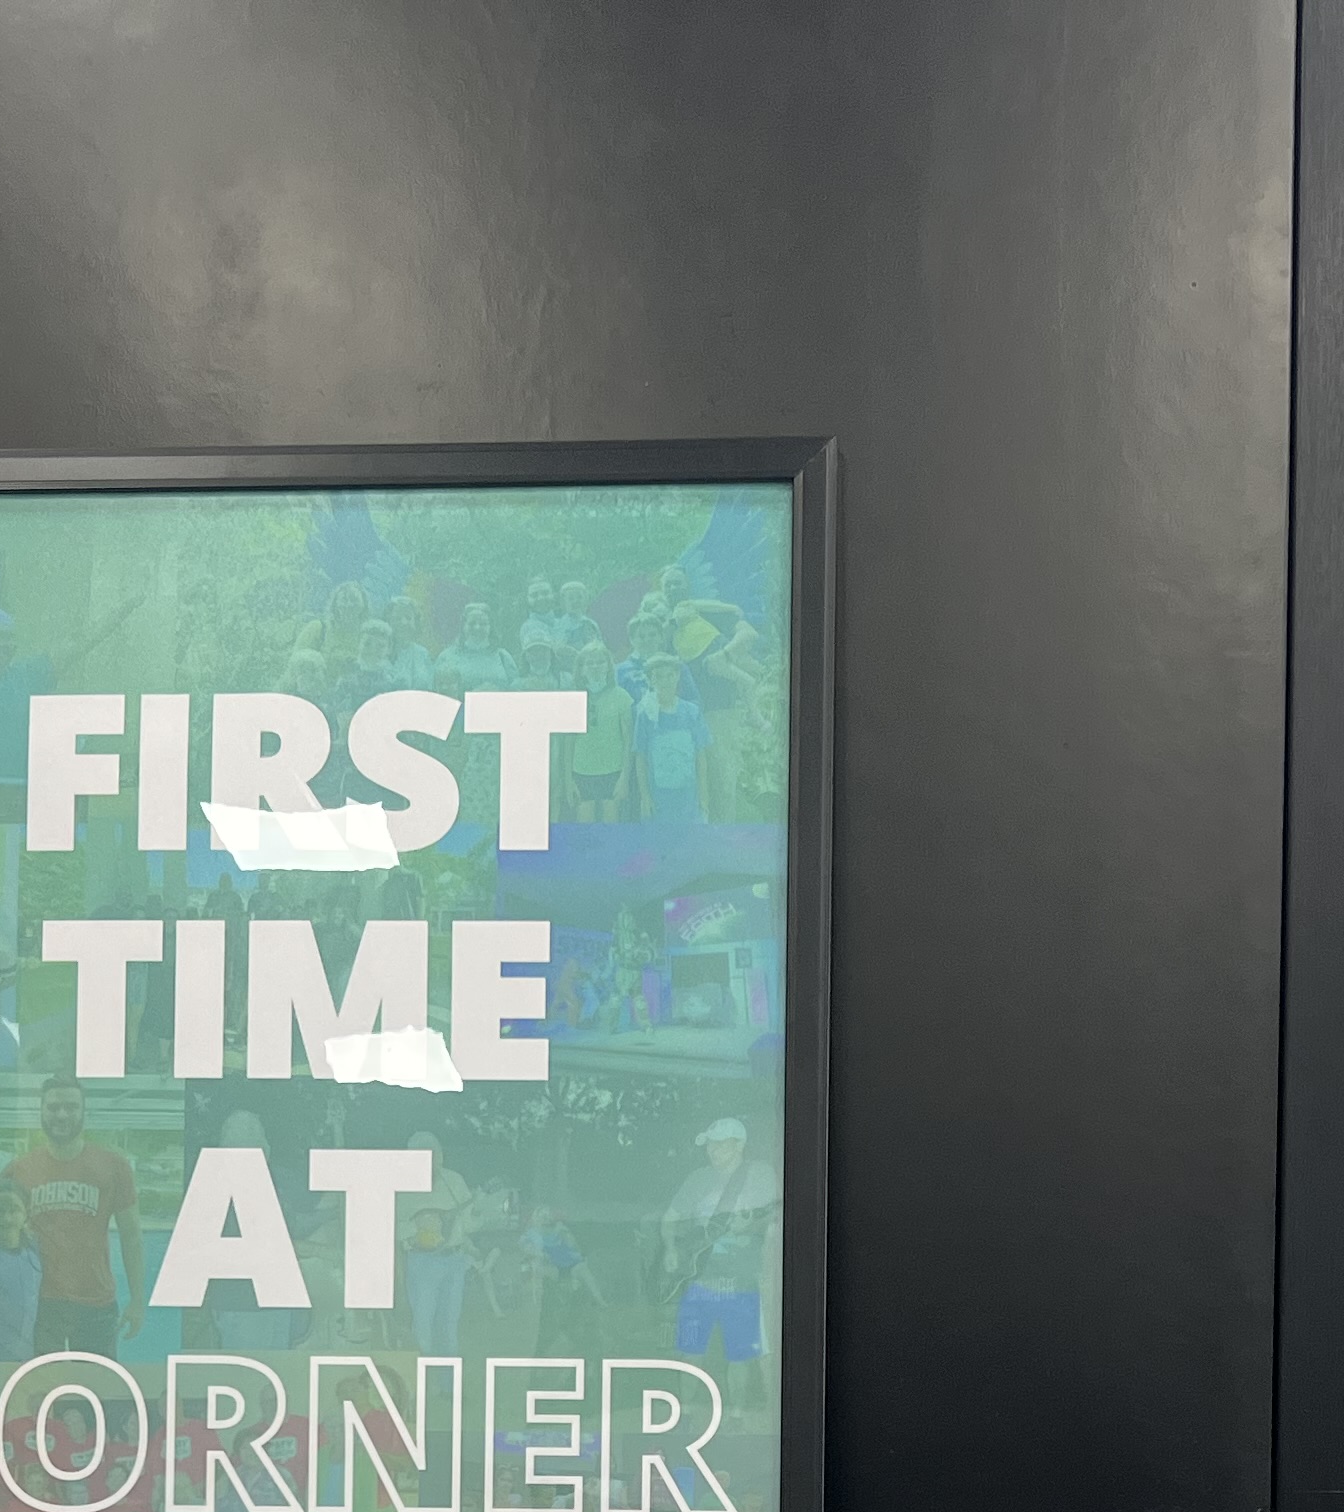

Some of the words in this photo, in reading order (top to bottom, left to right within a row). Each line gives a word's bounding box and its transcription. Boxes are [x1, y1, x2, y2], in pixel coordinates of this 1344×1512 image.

[25, 689, 588, 852] FIRST
[41, 919, 552, 1081] TIME
[148, 1147, 433, 1309] AT
